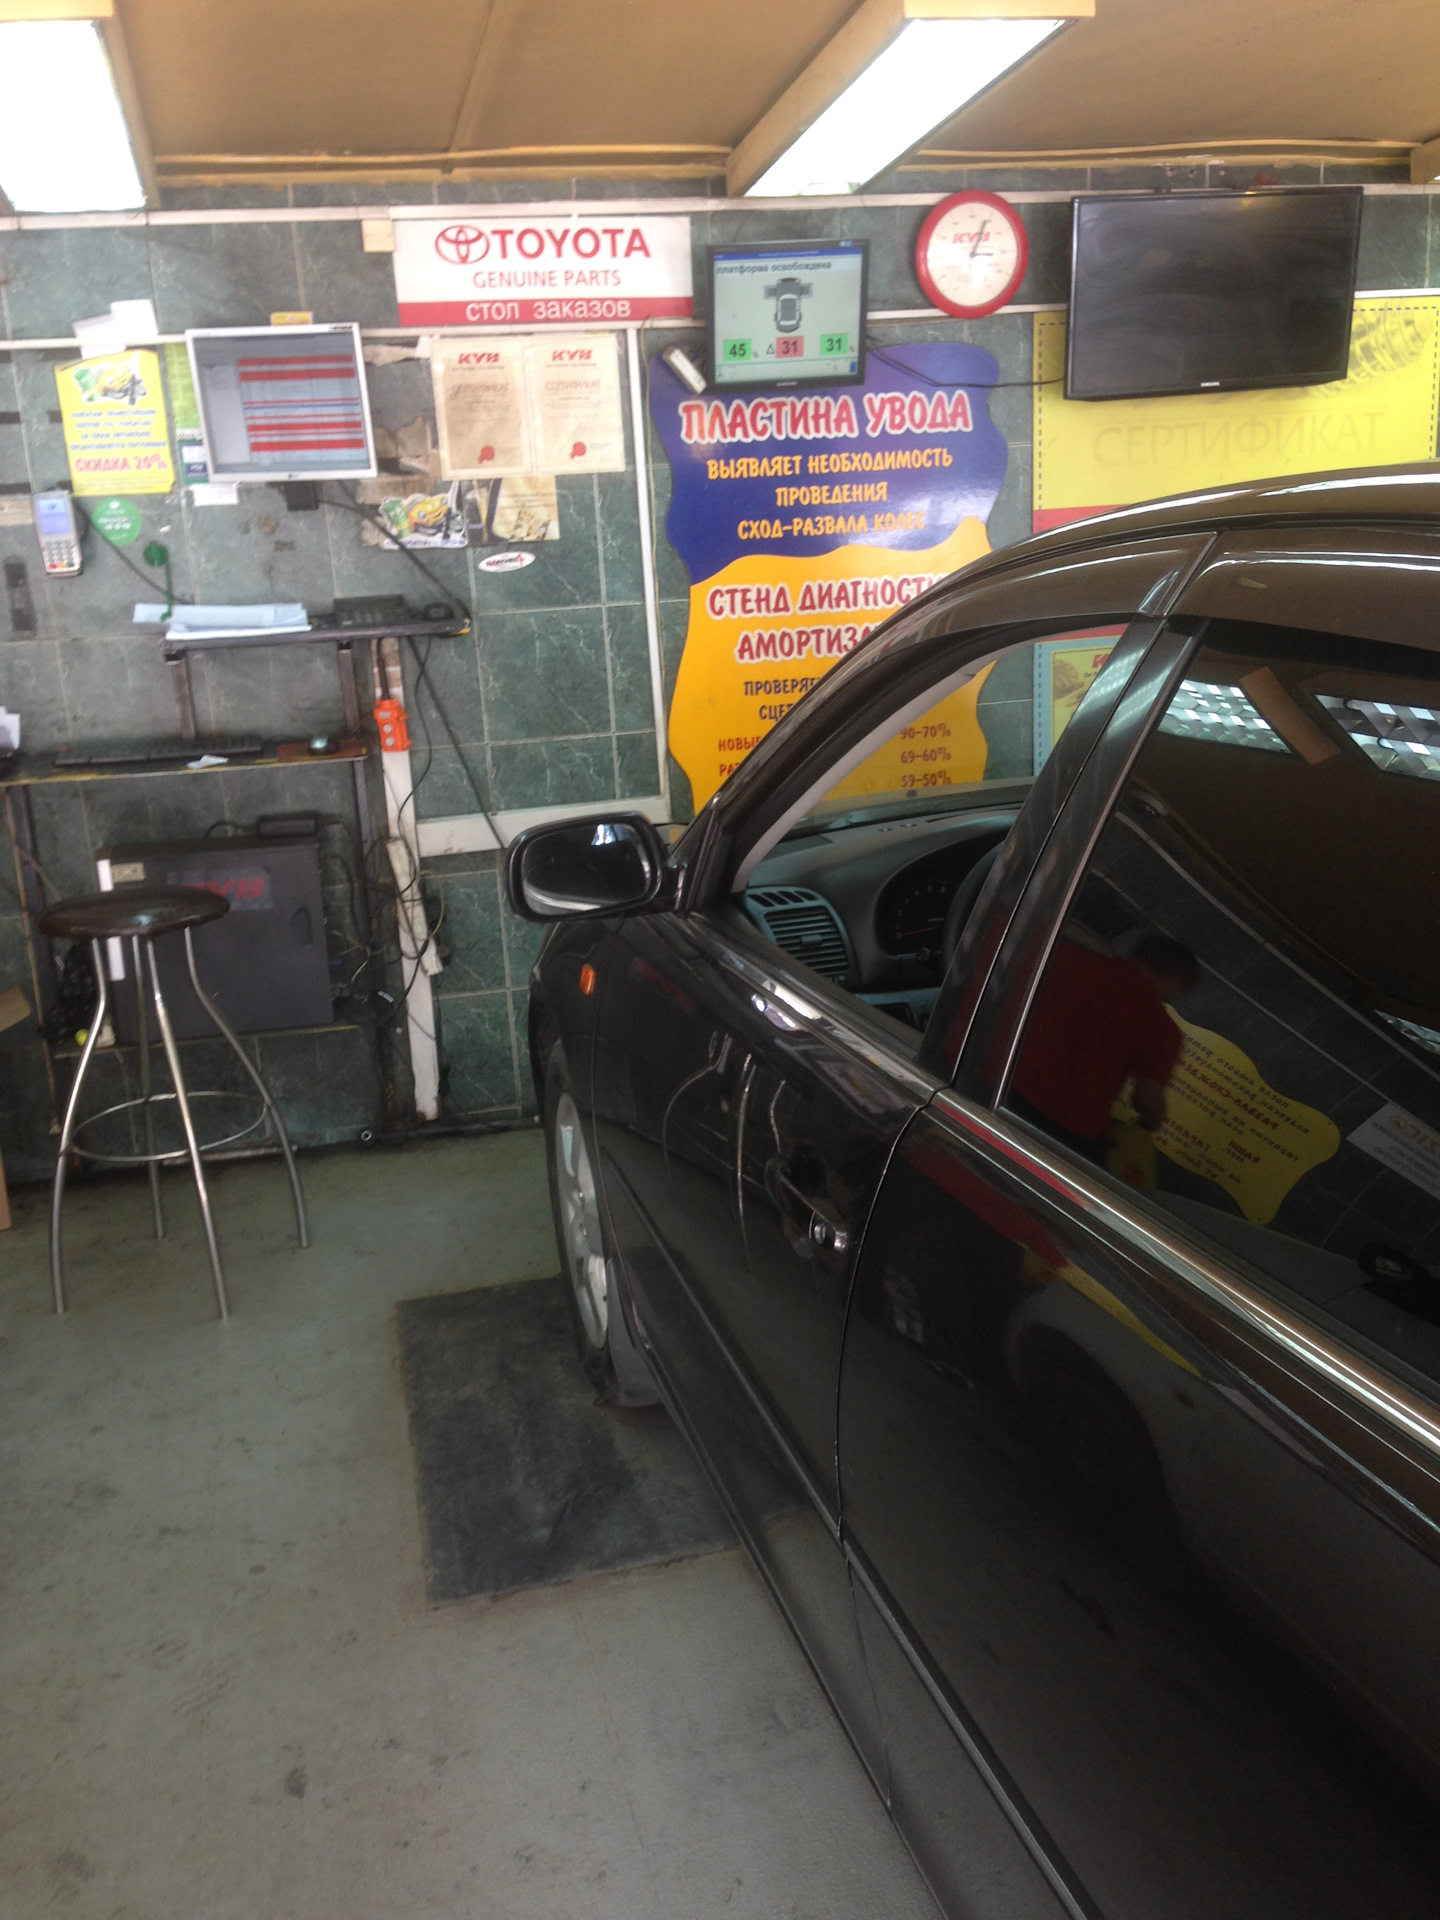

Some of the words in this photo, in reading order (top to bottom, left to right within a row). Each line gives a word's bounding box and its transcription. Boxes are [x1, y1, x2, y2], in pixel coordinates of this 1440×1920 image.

[490, 227, 651, 260] TOYOTA
[472, 270, 558, 289] GENUINE
[564, 269, 621, 286] PARTS
[729, 343, 747, 358] 45
[782, 340, 798, 355] 31
[826, 337, 842, 352] 31
[680, 395, 859, 443] ПЛАСТИНА
[863, 390, 972, 436] УВОДА
[1092, 411, 1385, 466] СЕРТИФИКАТ
[706, 455, 803, 480] ВЫЯВЛЯЕТ
[807, 447, 953, 475] НЕОБХОДИМОСТЬ
[776, 481, 888, 507] ПРОВЕДЕНИЯ
[737, 516, 868, 540] СХОД-РАЗВАЛА
[874, 510, 926, 532] КОЛЕС
[707, 585, 791, 618] СТЕНД
[736, 624, 877, 661] АМОРТИЗА
[759, 703, 793, 722] СЦЕ
[901, 723, 951, 740] 90-70%
[900, 746, 952, 764] 69-60%
[901, 770, 952, 788] 59-50%
